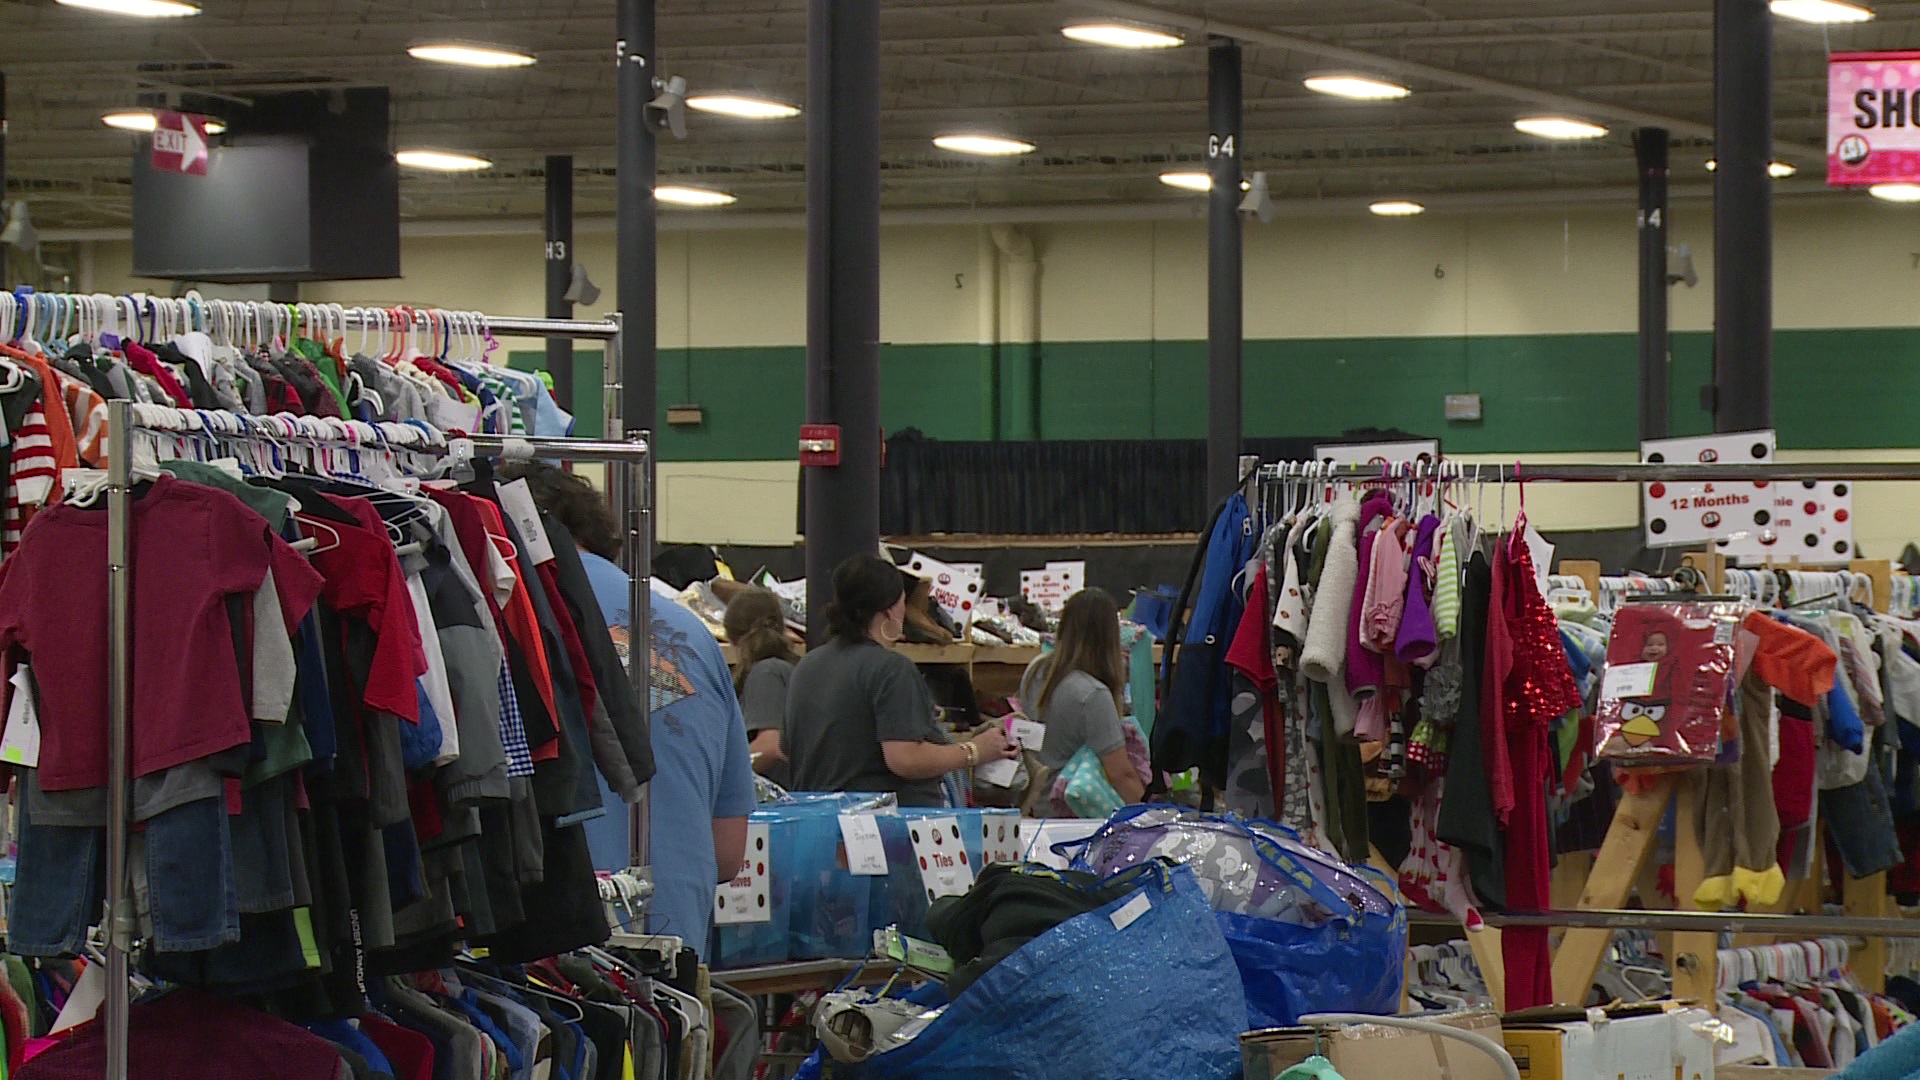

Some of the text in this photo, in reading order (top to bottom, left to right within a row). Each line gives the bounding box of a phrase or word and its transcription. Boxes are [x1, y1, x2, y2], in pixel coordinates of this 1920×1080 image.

[154, 128, 187, 154] EXIT
[1209, 134, 1234, 158] G4
[545, 240, 565, 260] H3
[1434, 263, 1445, 279] 6
[808, 429, 828, 437] FIRE
[1704, 483, 1714, 493] &
[1671, 494, 1750, 510] 12 Months
[935, 587, 960, 608] SHOES
[932, 853, 954, 868] Ties
[350, 909, 362, 946] UNDER
